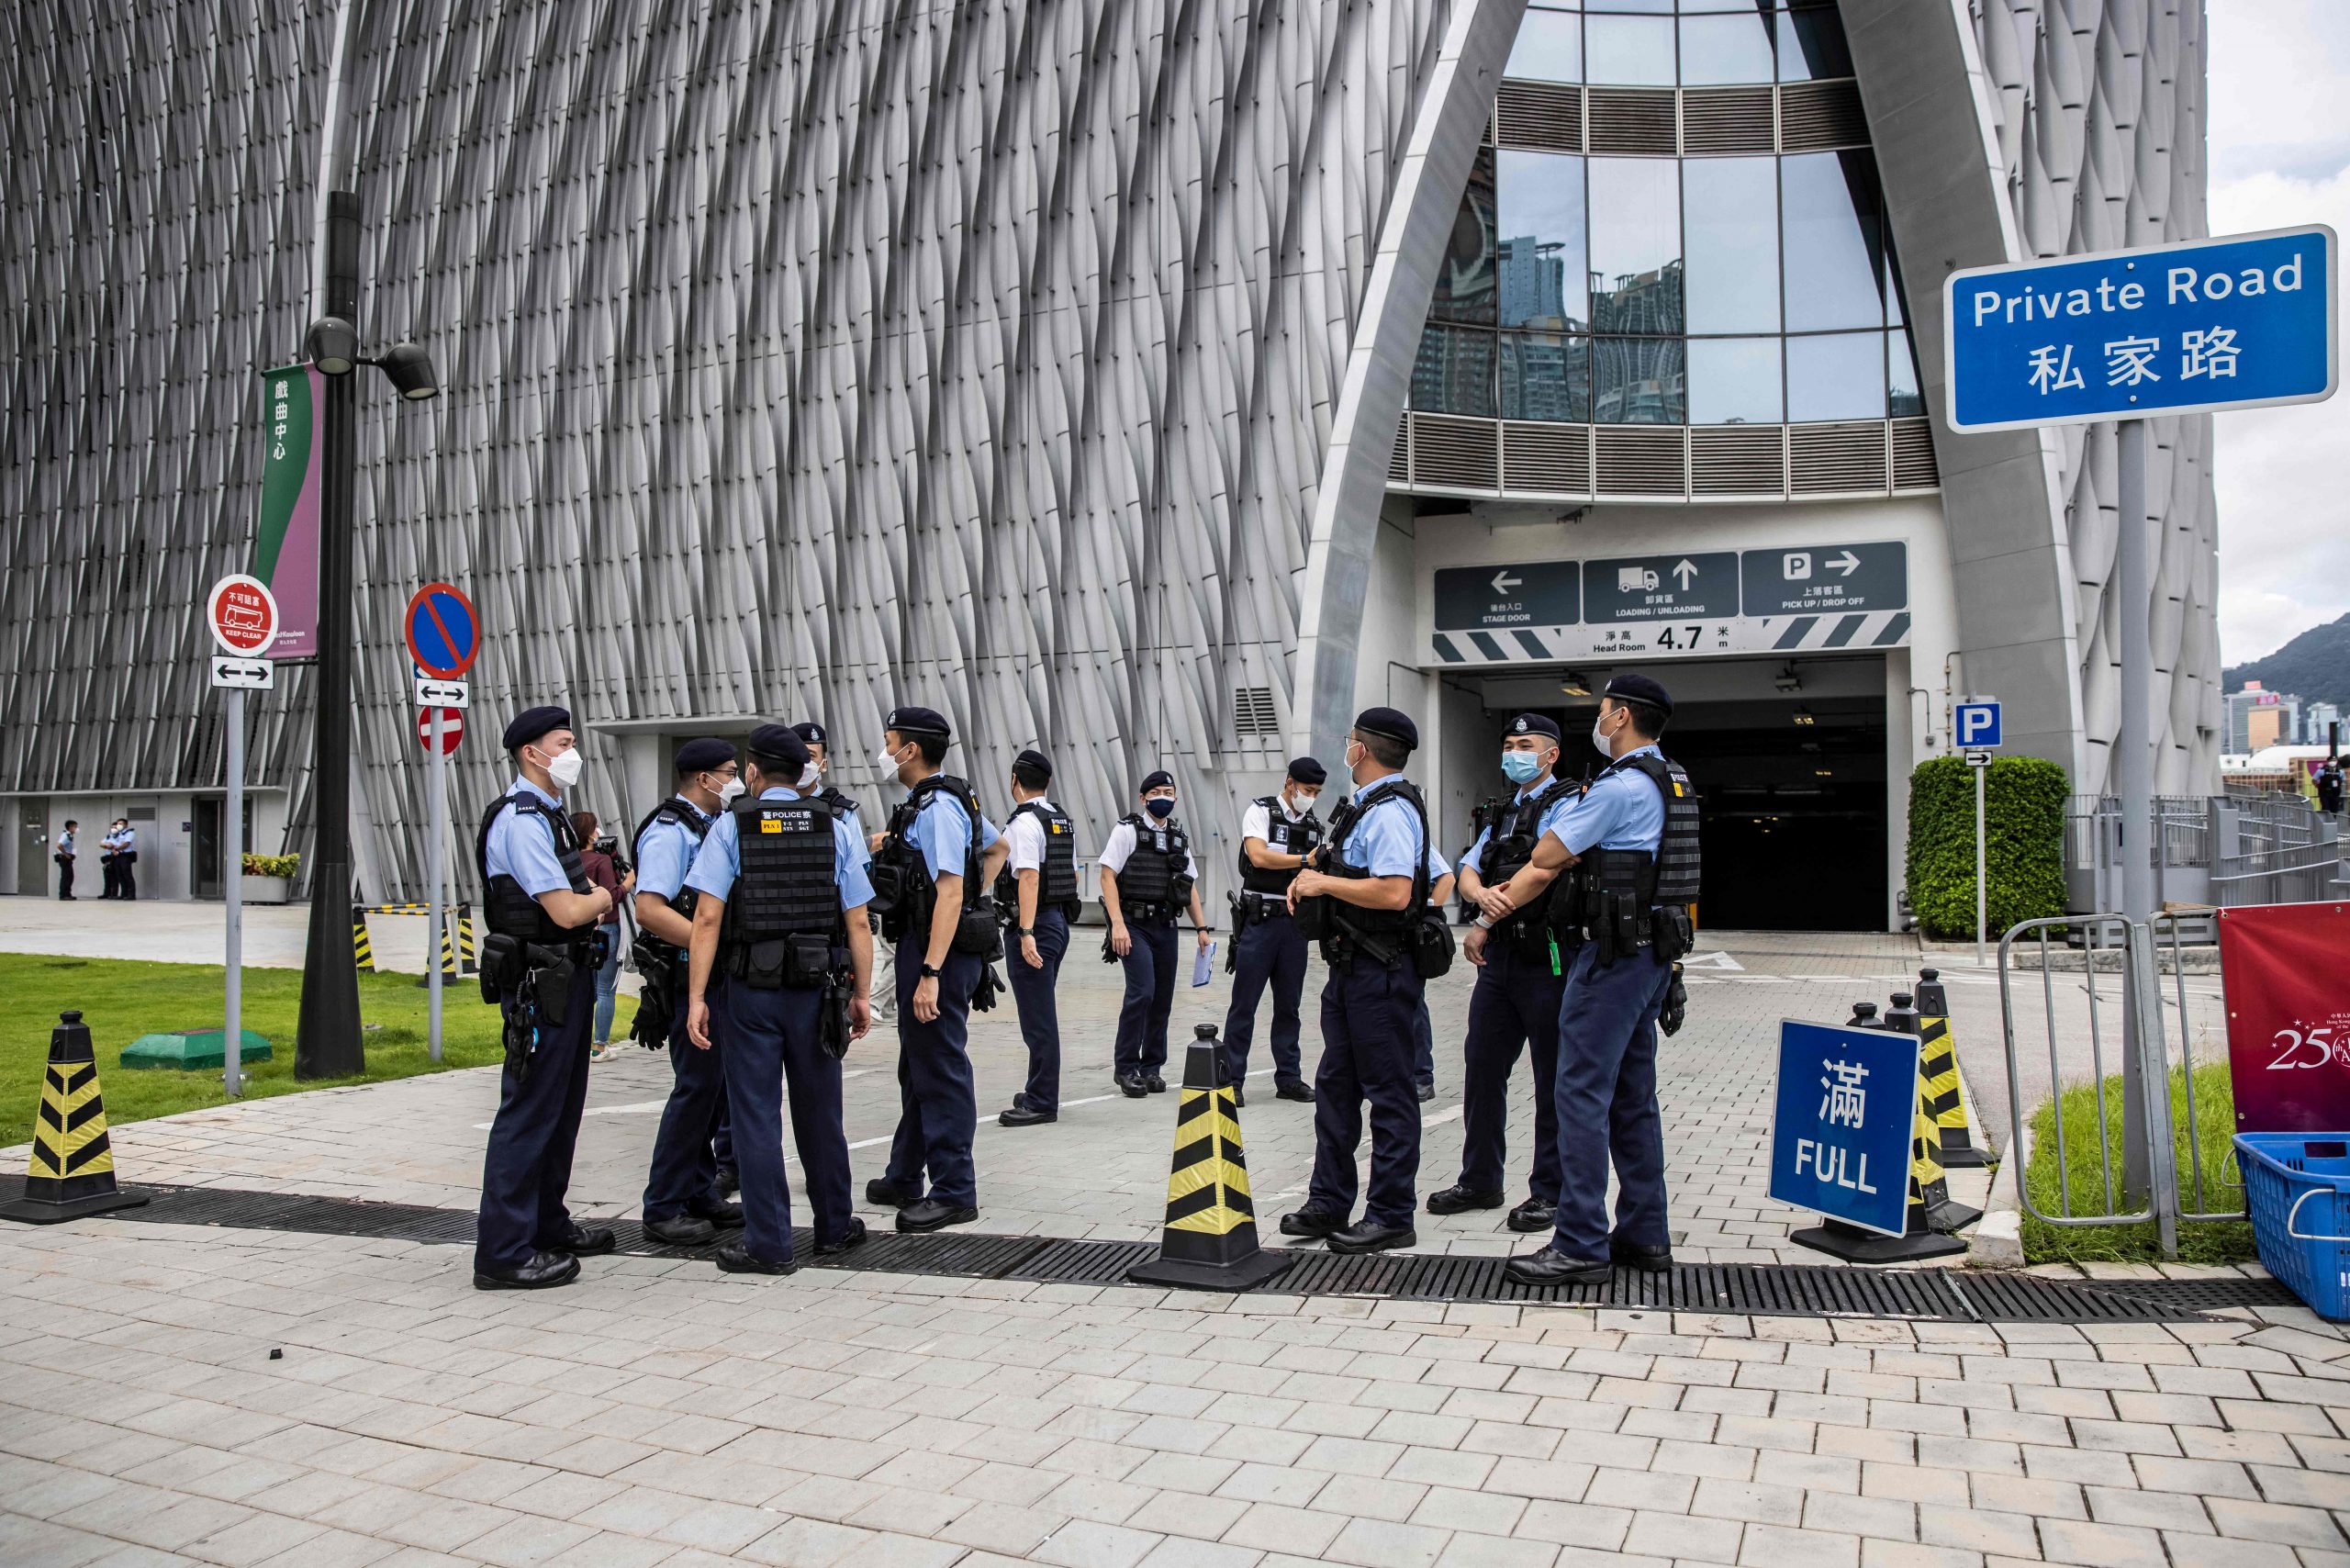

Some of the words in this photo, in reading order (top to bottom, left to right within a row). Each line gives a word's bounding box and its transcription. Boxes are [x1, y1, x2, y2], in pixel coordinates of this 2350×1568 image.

[1975, 277, 2145, 327] Private
[2167, 253, 2302, 305] Road
[2028, 325, 2242, 395] 私家路
[274, 380, 288, 460] 戲曲中心
[1790, 557, 1805, 575] P
[229, 592, 260, 606] 不可阻塞
[1803, 586, 1843, 597] 上落客區
[1491, 603, 1522, 612] 後台入口
[1616, 608, 1651, 617] LOADING
[1658, 605, 1705, 615] UNLOADING
[1782, 599, 1803, 609] PICK
[1804, 599, 1816, 608] UP
[1822, 598, 1846, 607] DROP
[1848, 597, 1864, 605] OFF
[1483, 614, 1506, 622] STAGE
[1507, 613, 1530, 622] DOOR
[1657, 626, 1702, 650] 4.7
[1718, 626, 1729, 636] 米
[1594, 644, 1617, 653] Head
[1619, 643, 1645, 652] Room
[1964, 708, 1992, 743] P
[2266, 1028, 2332, 1070] 25
[2335, 1043, 2343, 1052] th
[1818, 1058, 1869, 1129] 滿
[1796, 1137, 1877, 1195] FULL
